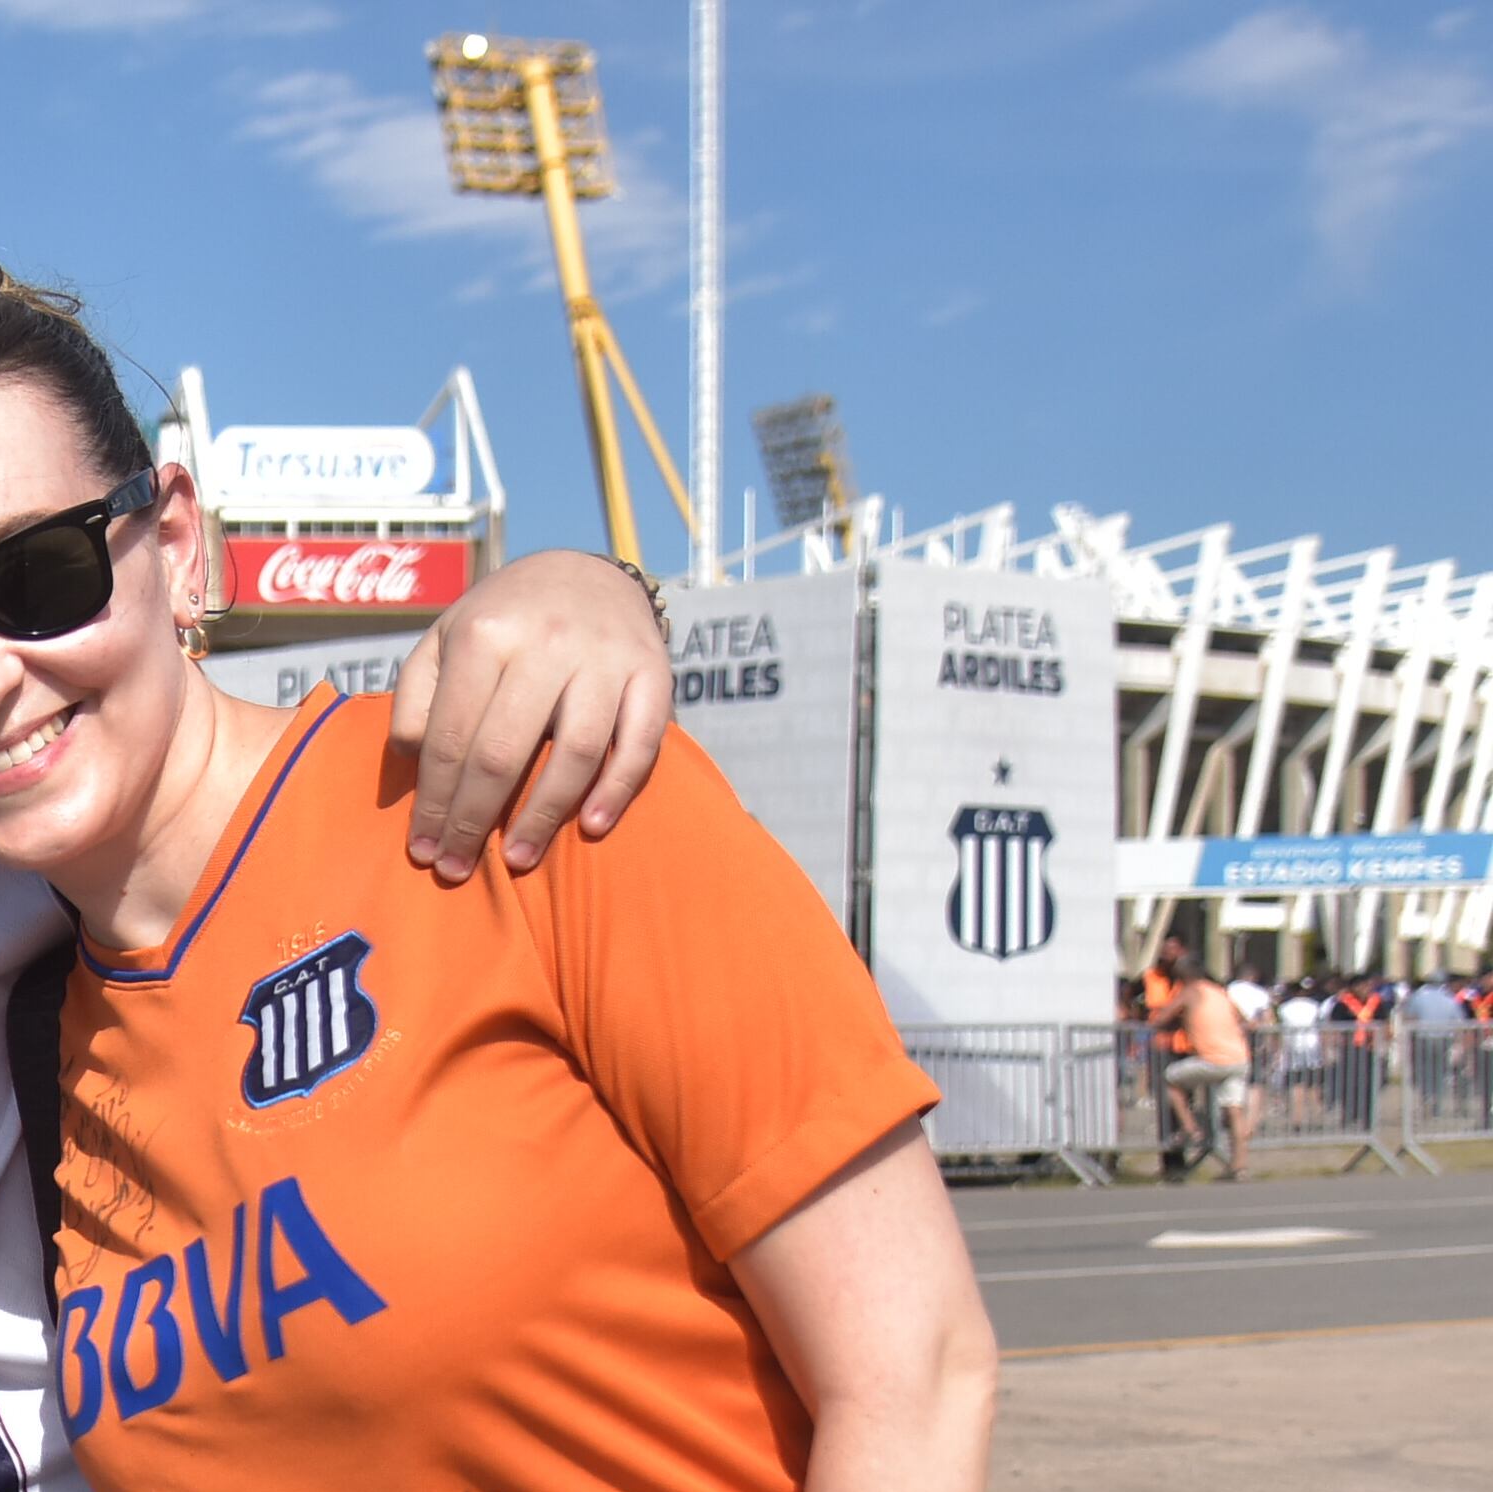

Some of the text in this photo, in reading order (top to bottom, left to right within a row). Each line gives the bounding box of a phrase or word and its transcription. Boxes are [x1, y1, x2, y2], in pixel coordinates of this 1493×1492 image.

[238, 442, 408, 478] Tersuave
[943, 601, 1063, 651] PLATEA
[672, 659, 783, 707] DILES
[937, 649, 1066, 697] ARDILES
[1223, 854, 1465, 883] ESTADIO KEMPES
[273, 956, 329, 995] C.A.T
[56, 1176, 389, 1441] BBVA
